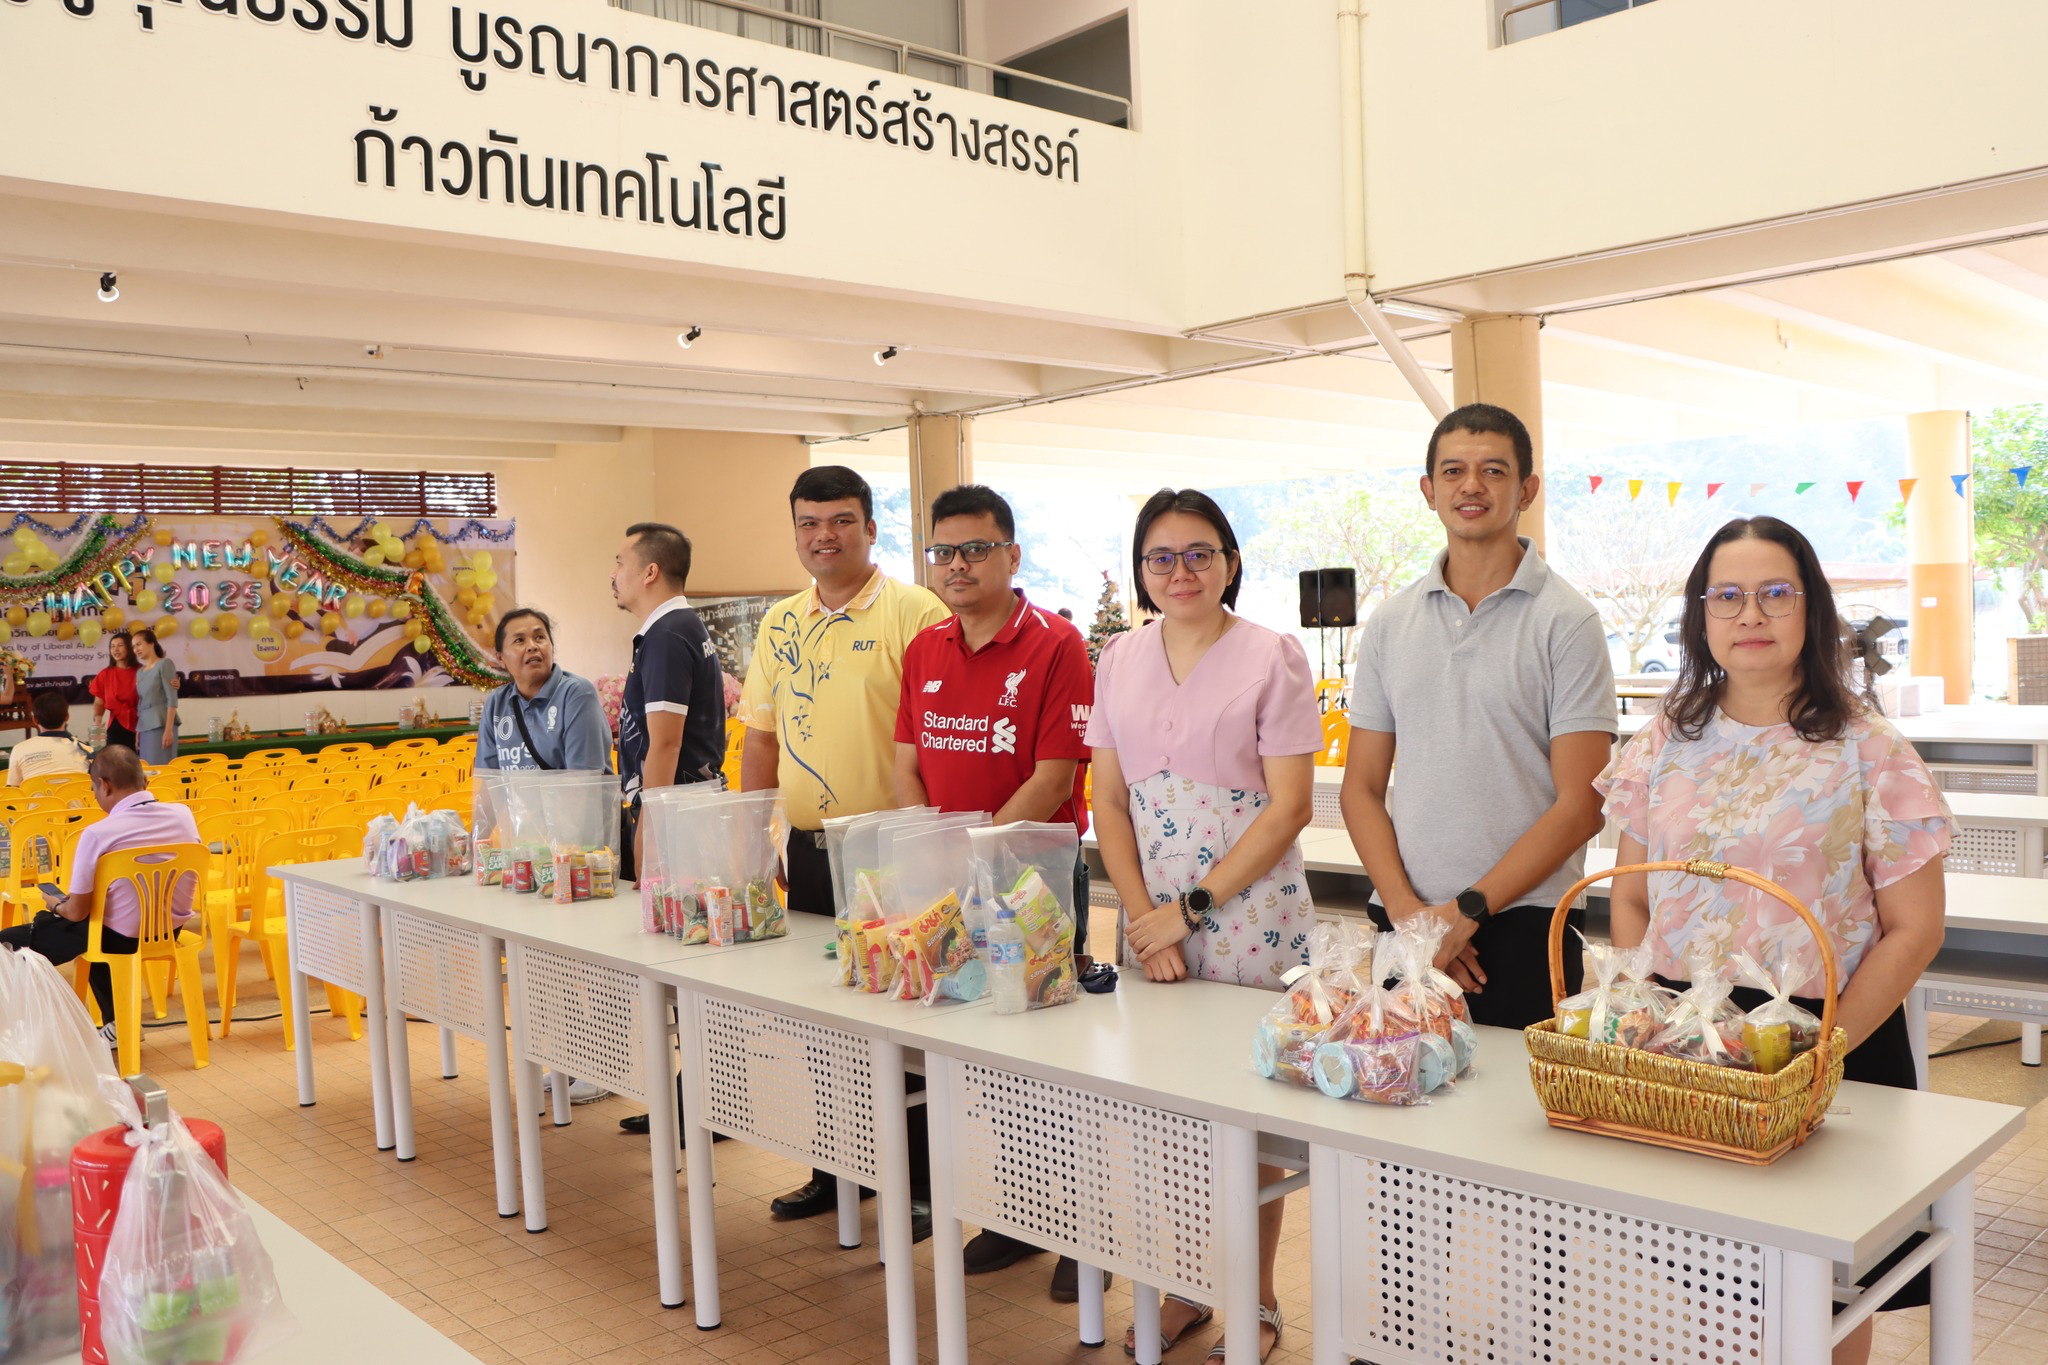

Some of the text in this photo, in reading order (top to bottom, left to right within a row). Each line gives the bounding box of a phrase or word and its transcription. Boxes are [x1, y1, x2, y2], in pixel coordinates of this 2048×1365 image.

[452, 6, 1080, 183] บูรณาการศาสตร์สร้างสรรค์
[354, 105, 786, 240] ก้าวทันเทคโนโลยี
[45, 537, 347, 623] HAPPY NEW YEAR
[162, 581, 262, 614] 2025
[44, 642, 73, 650] Liberal
[44, 653, 95, 662] Technology
[923, 711, 989, 732] Standard
[496, 742, 533, 764] ing's
[921, 731, 987, 753] Chartered
